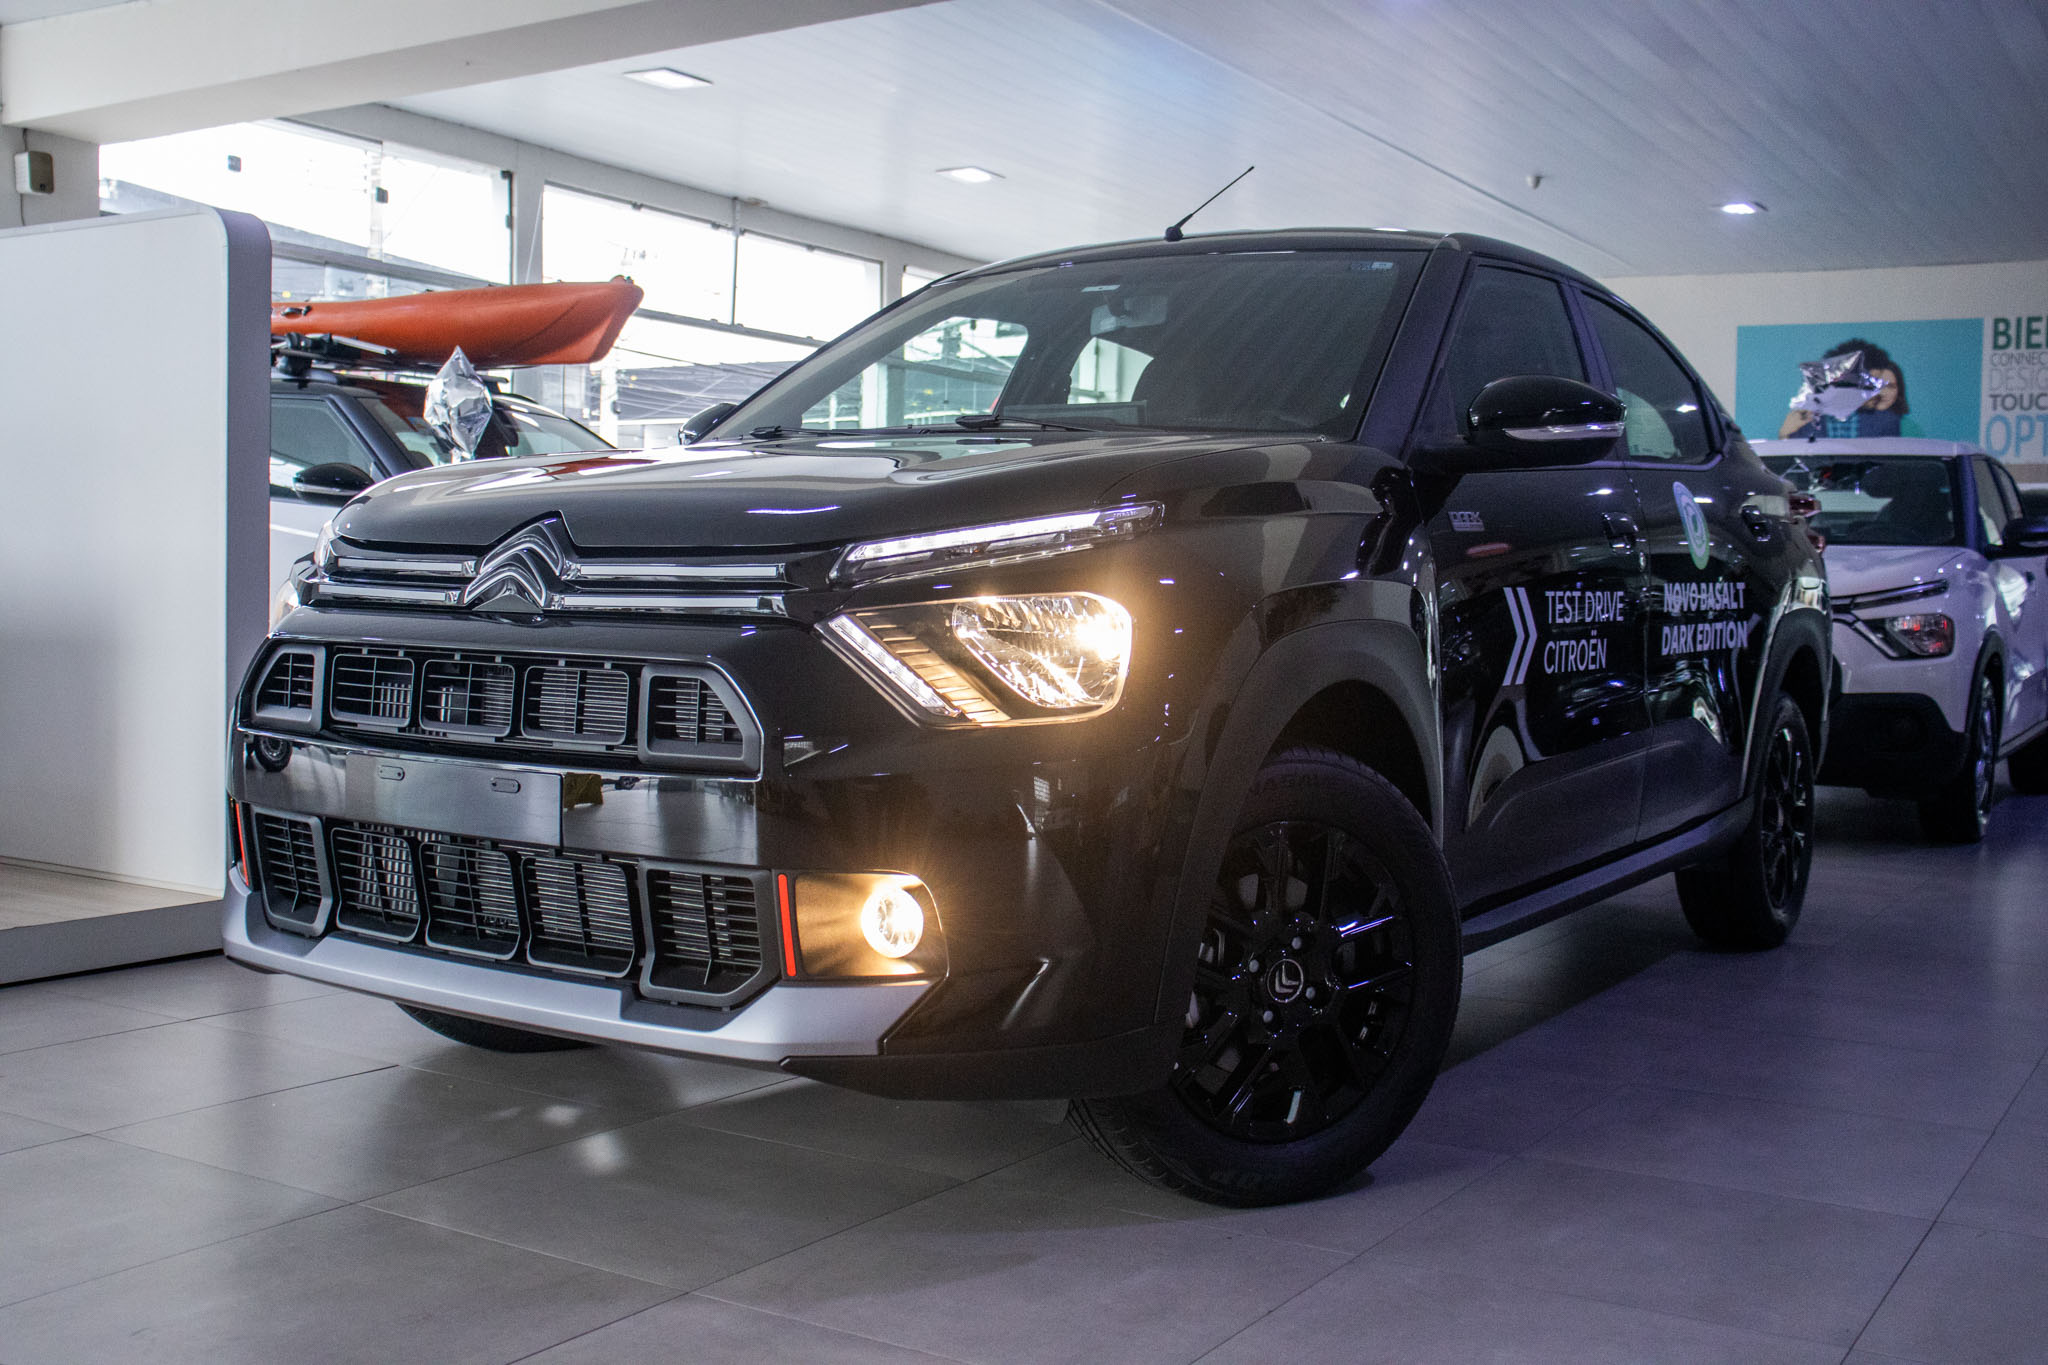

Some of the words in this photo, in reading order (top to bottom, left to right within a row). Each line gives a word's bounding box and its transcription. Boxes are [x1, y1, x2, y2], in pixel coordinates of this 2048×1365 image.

[1992, 316, 2048, 350] BIE
[1545, 591, 1582, 624] TEST
[1585, 591, 1624, 622] DRIVE
[1664, 582, 1698, 613] NOVO
[1700, 582, 1746, 611] BASALT
[1544, 630, 1607, 674] CITROËN
[1661, 623, 1696, 656] DARK
[1696, 621, 1748, 652] EDITION
